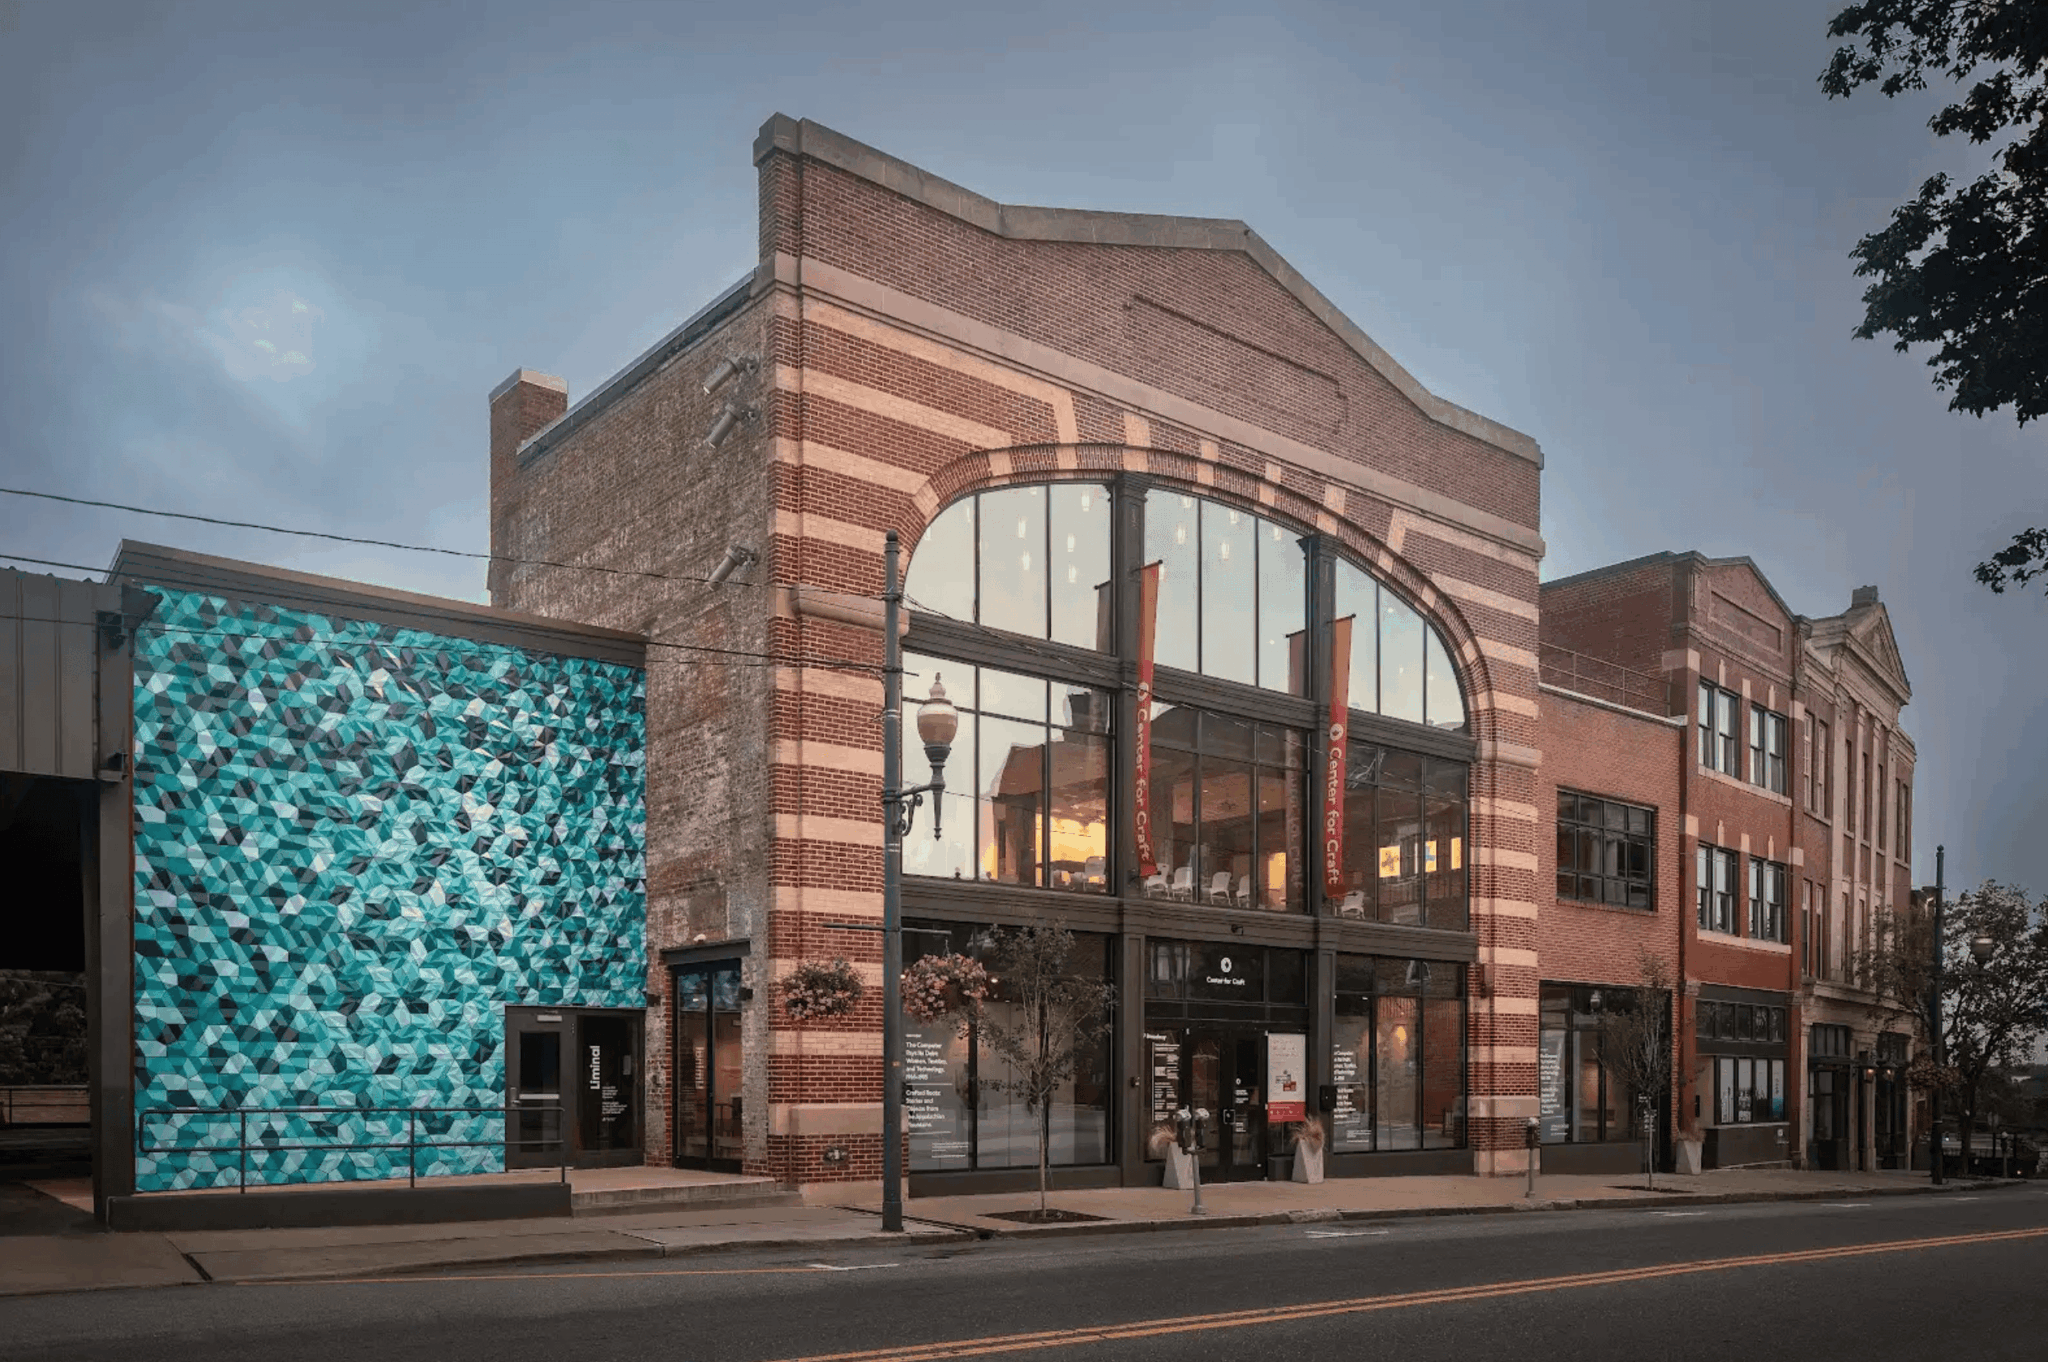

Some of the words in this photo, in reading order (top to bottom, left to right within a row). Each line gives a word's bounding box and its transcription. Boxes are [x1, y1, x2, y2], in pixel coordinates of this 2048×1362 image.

[1135, 708, 1148, 773] Center
[1135, 778, 1147, 807] for
[1327, 747, 1343, 806] Center
[1136, 811, 1151, 860] Craft
[1327, 810, 1340, 835] for
[1326, 839, 1340, 885] Craft
[1232, 978, 1246, 986] Craft
[589, 1045, 600, 1090] Liminal
